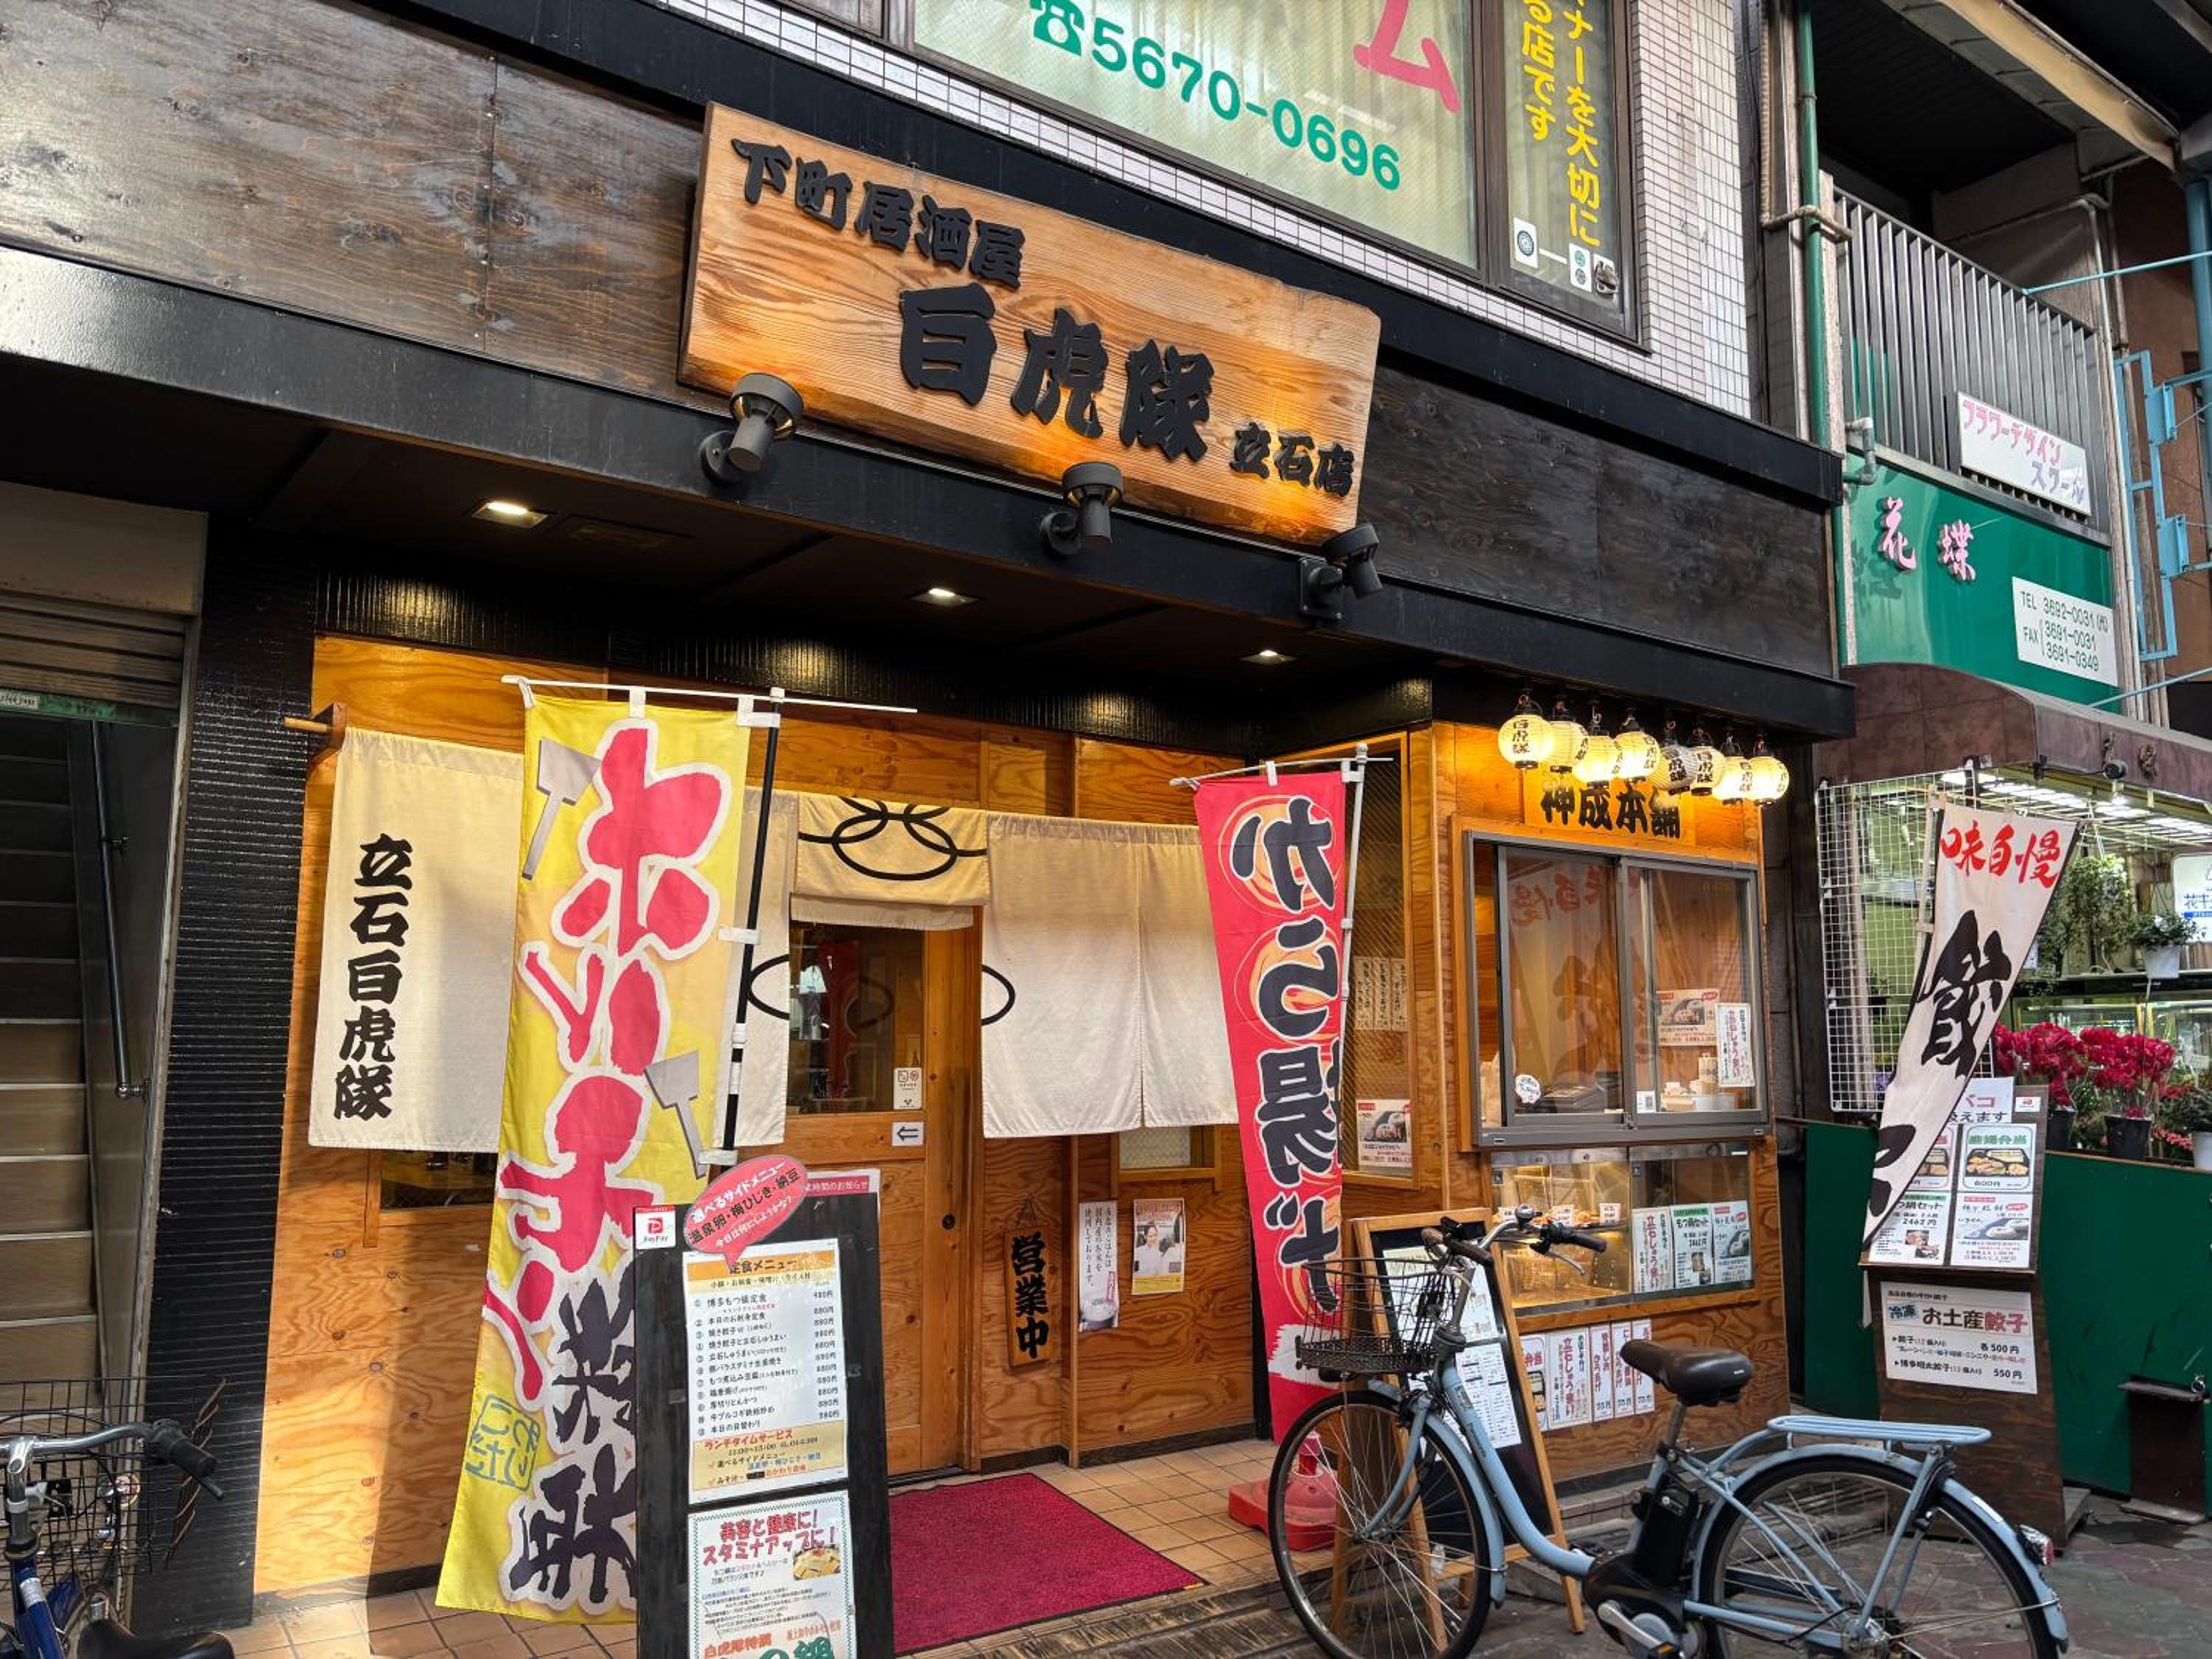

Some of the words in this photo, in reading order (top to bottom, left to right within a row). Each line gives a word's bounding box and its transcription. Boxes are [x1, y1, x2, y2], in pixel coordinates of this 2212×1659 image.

[1091, 17, 1402, 191] 5670-0696
[1563, 0, 1600, 247] ナーを大切に
[731, 138, 1026, 290] 下町居酒屋
[899, 282, 1213, 461] 白虎隊
[1230, 421, 1354, 498] 立石店
[1962, 399, 2062, 466] フラワーデザイン
[2031, 460, 2084, 504] スクール
[2020, 591, 2037, 610] TEL
[2023, 626, 2039, 644] FAX
[1939, 819, 2061, 889] 味自慢
[333, 833, 413, 1121] 立石白虎隊
[692, 1162, 785, 1223] 選べるサイドメニュー
[729, 1259, 798, 1275] 定食メニュー
[1011, 1237, 1051, 1357] 営業中
[1922, 1307, 2028, 1334] お土産餃子
[704, 1429, 794, 1450] ランチタイムサービス
